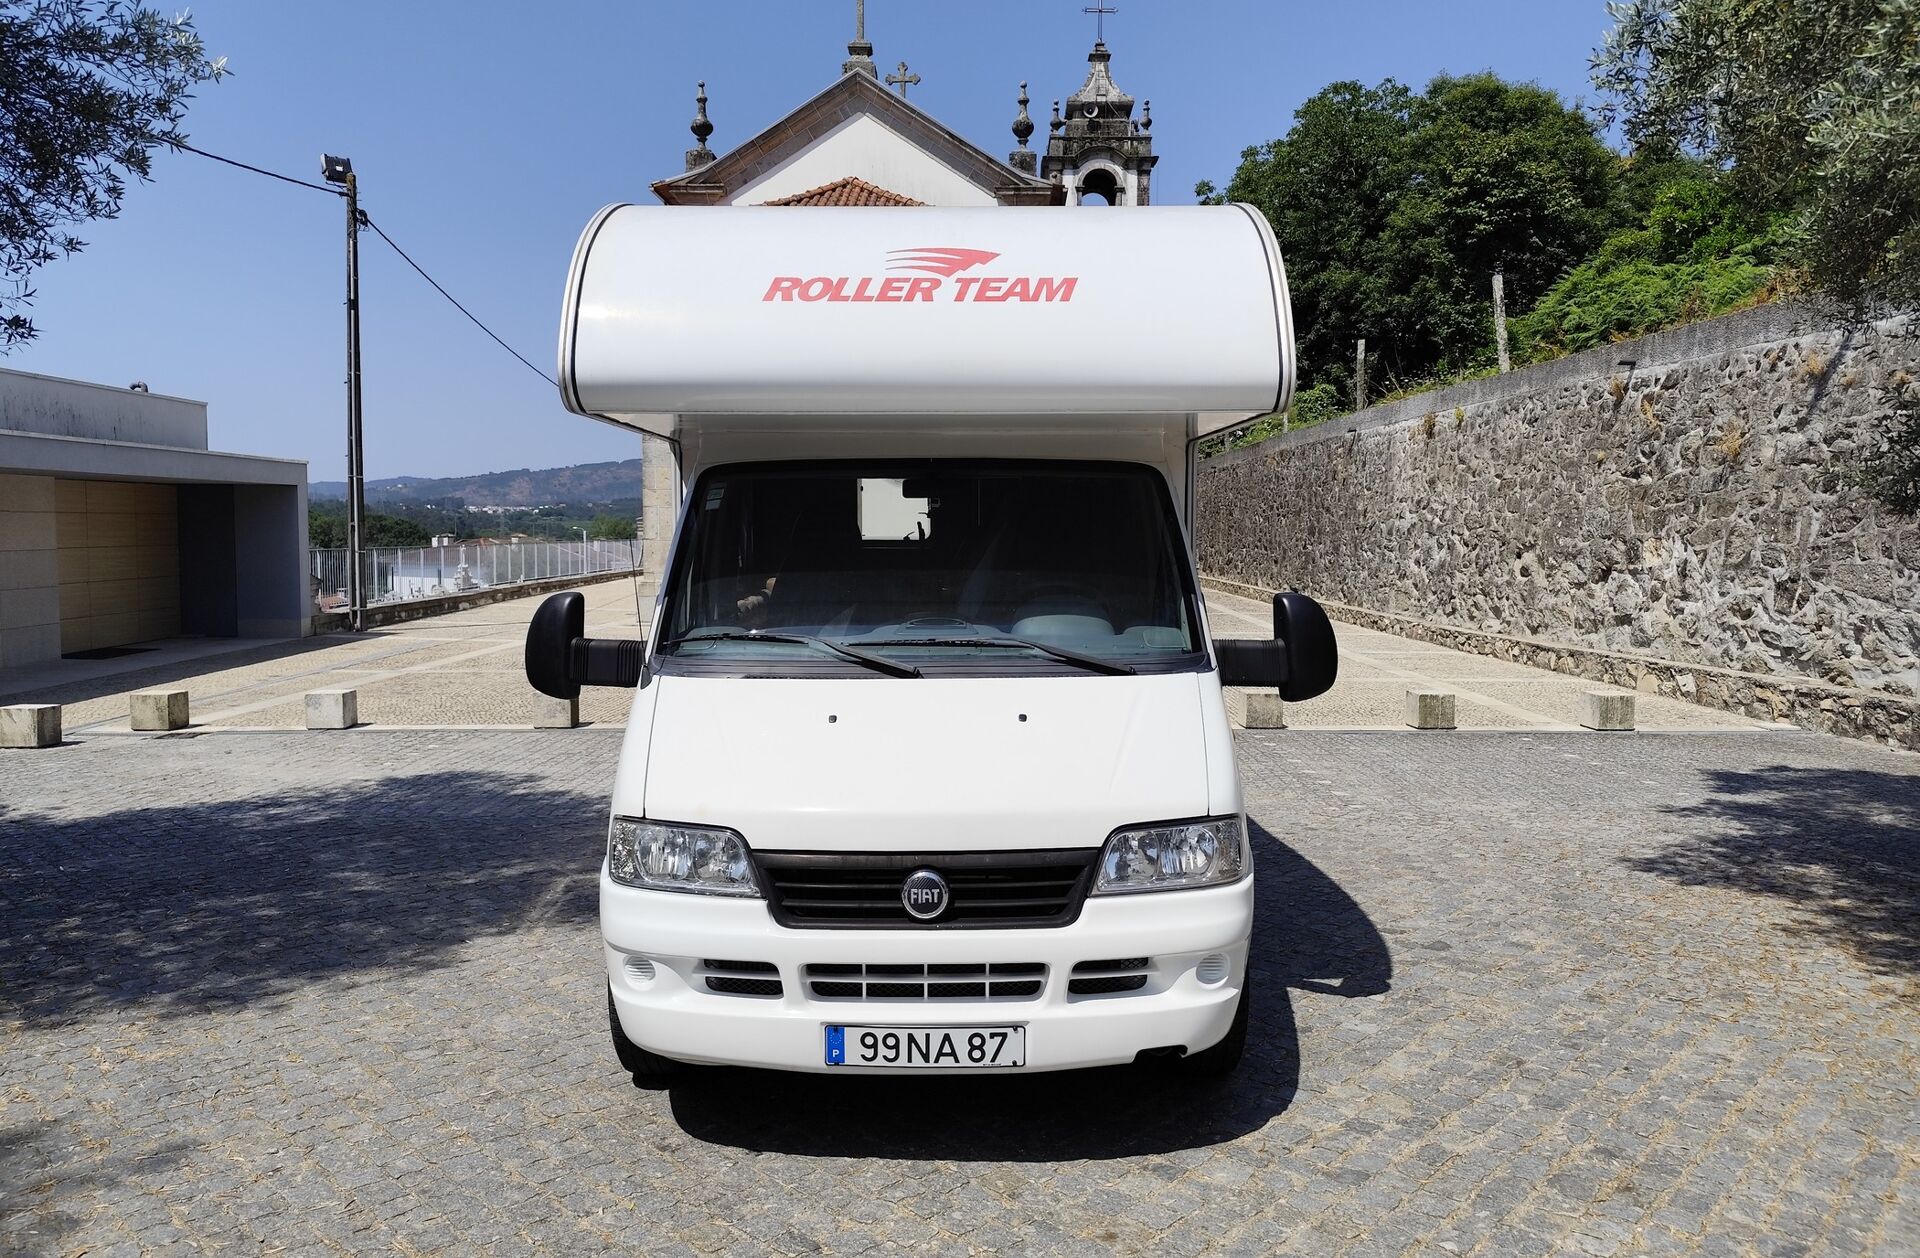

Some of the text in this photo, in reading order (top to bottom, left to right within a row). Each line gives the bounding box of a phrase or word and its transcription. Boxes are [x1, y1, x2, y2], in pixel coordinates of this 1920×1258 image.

[762, 276, 1078, 302] ROLLER TEAM
[910, 888, 940, 904] FIAT
[832, 1049, 840, 1058] P
[967, 1032, 1008, 1064] 87
